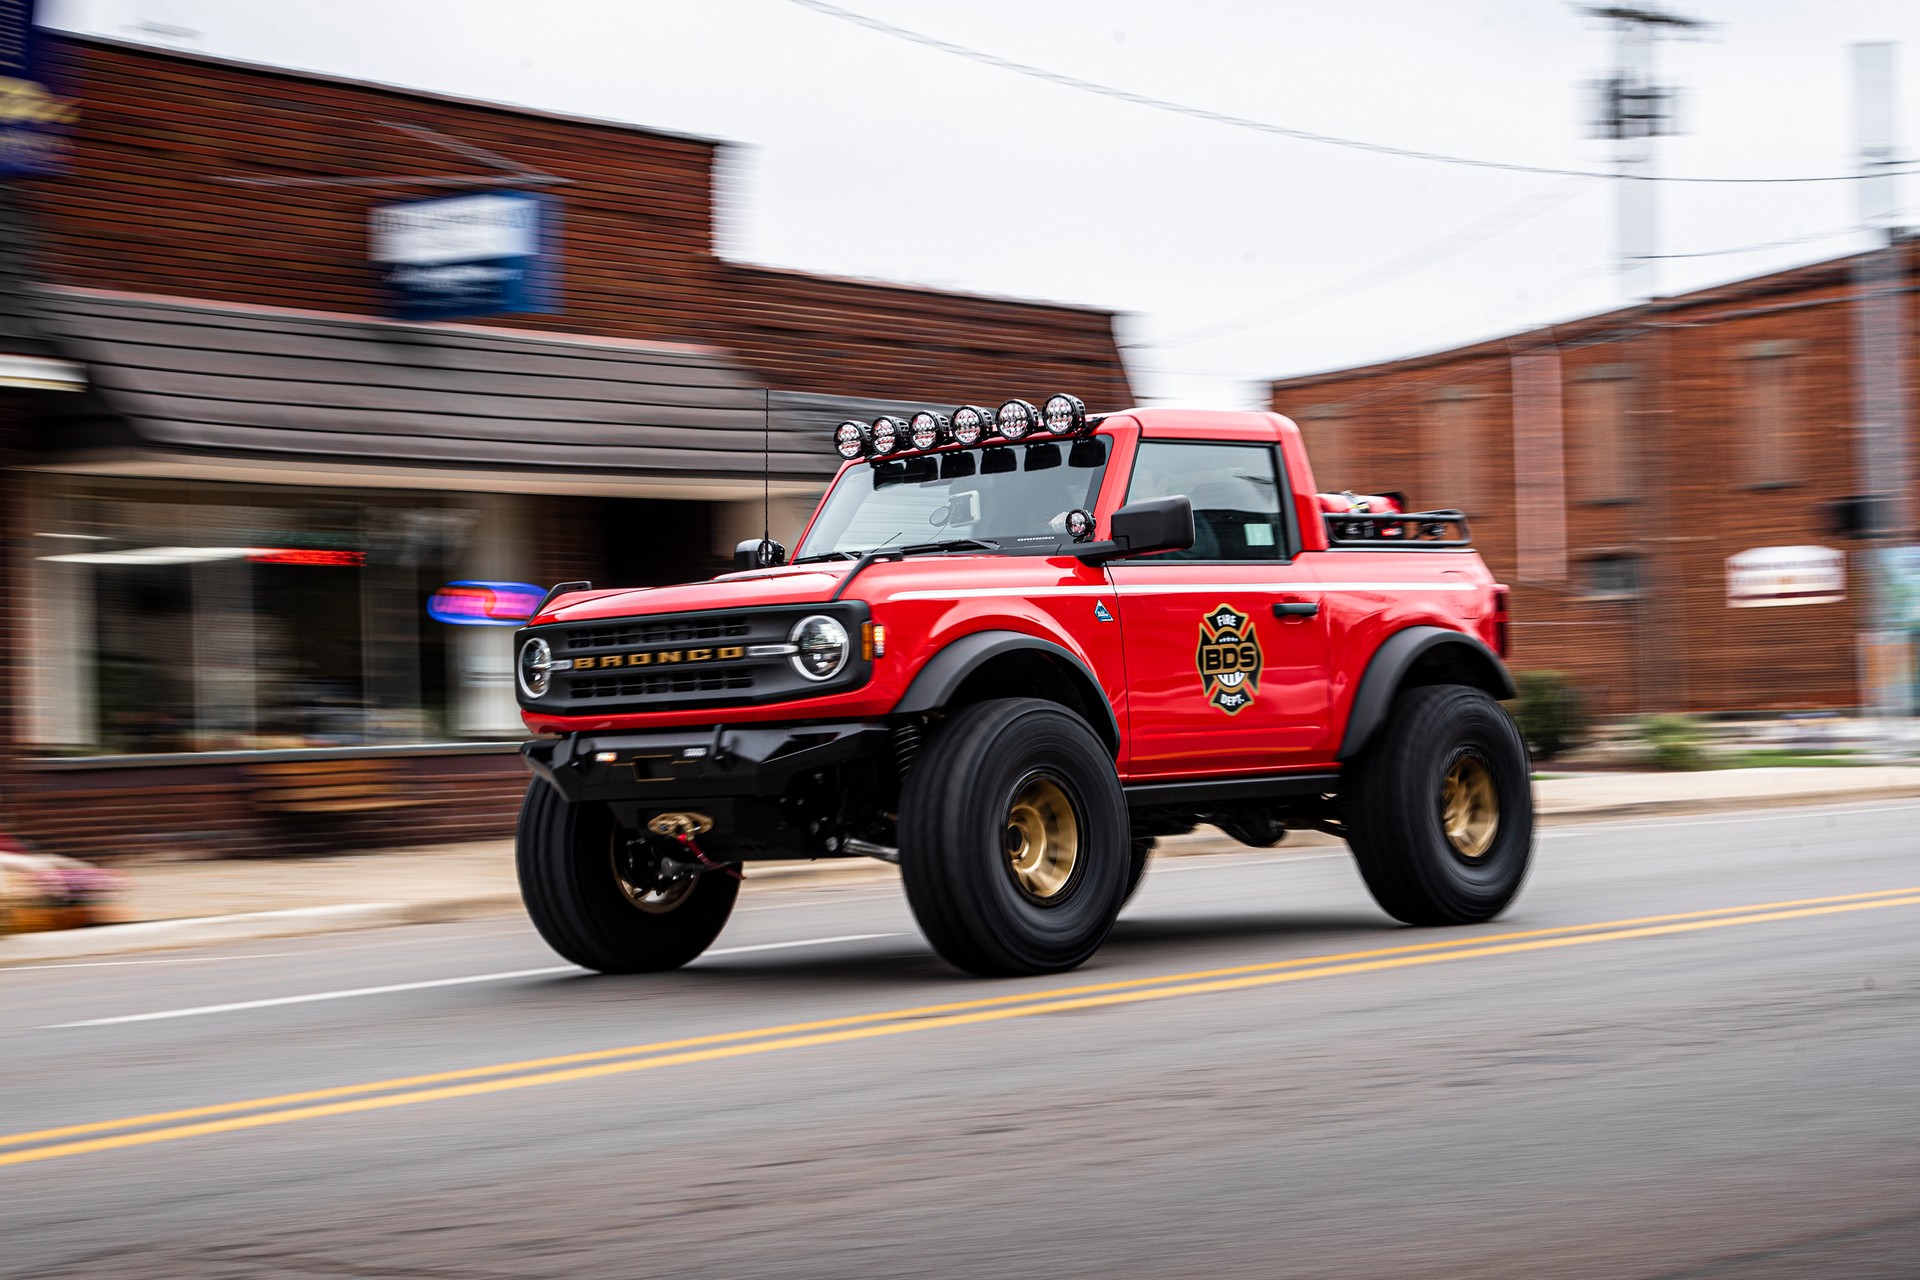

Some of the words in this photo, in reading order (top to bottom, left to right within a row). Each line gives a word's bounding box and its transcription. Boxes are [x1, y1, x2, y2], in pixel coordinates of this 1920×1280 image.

[1216, 614, 1237, 627] FIRE
[573, 646, 744, 670] BRONCO
[1204, 644, 1256, 672] BDS
